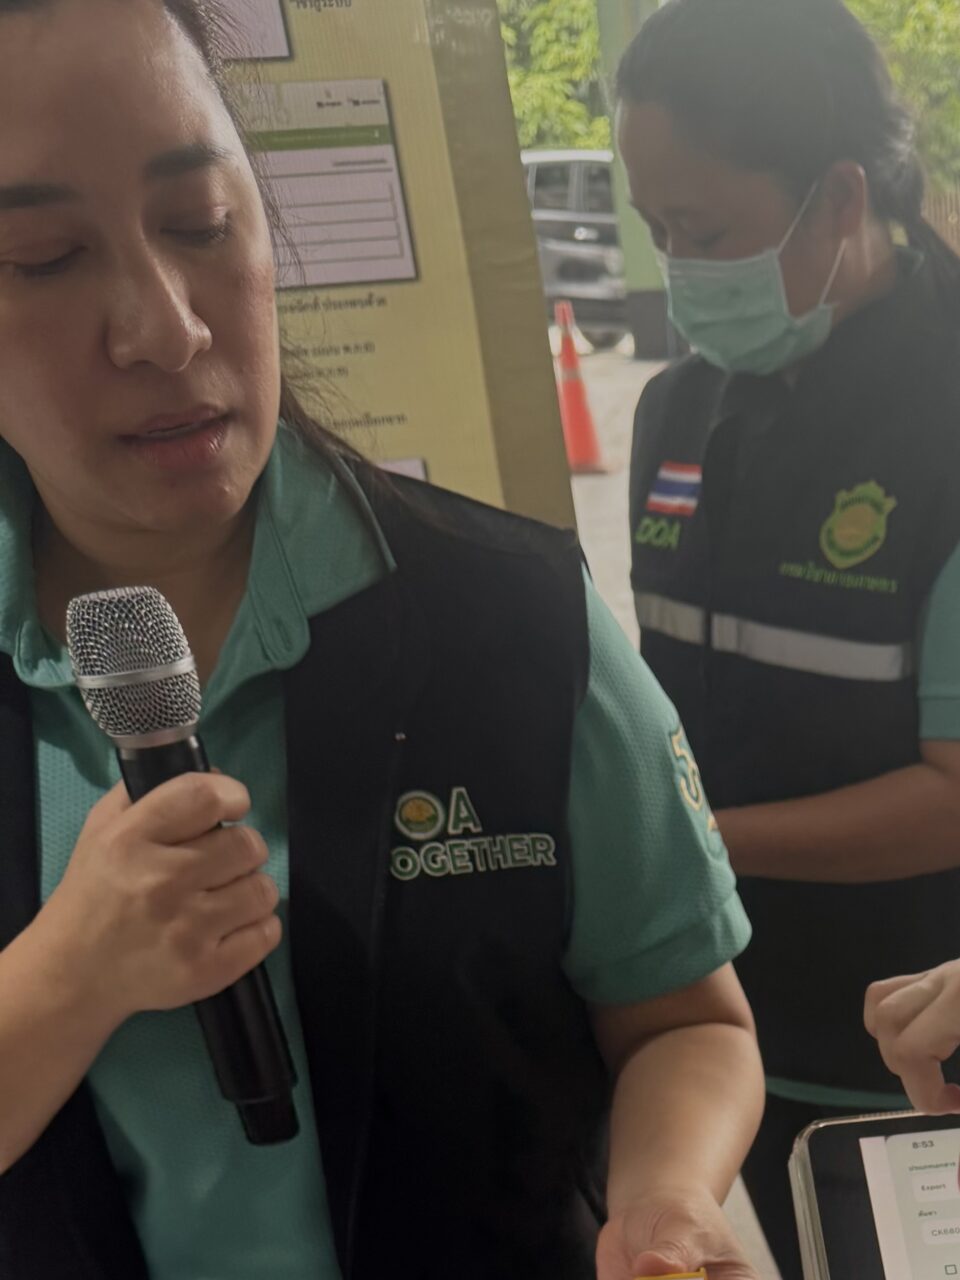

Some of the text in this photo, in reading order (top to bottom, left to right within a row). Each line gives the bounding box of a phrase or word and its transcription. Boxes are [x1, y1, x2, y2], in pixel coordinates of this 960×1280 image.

[635, 516, 681, 550] DOA
[912, 1139, 935, 1150] 8:53
[921, 1182, 946, 1193] Export
